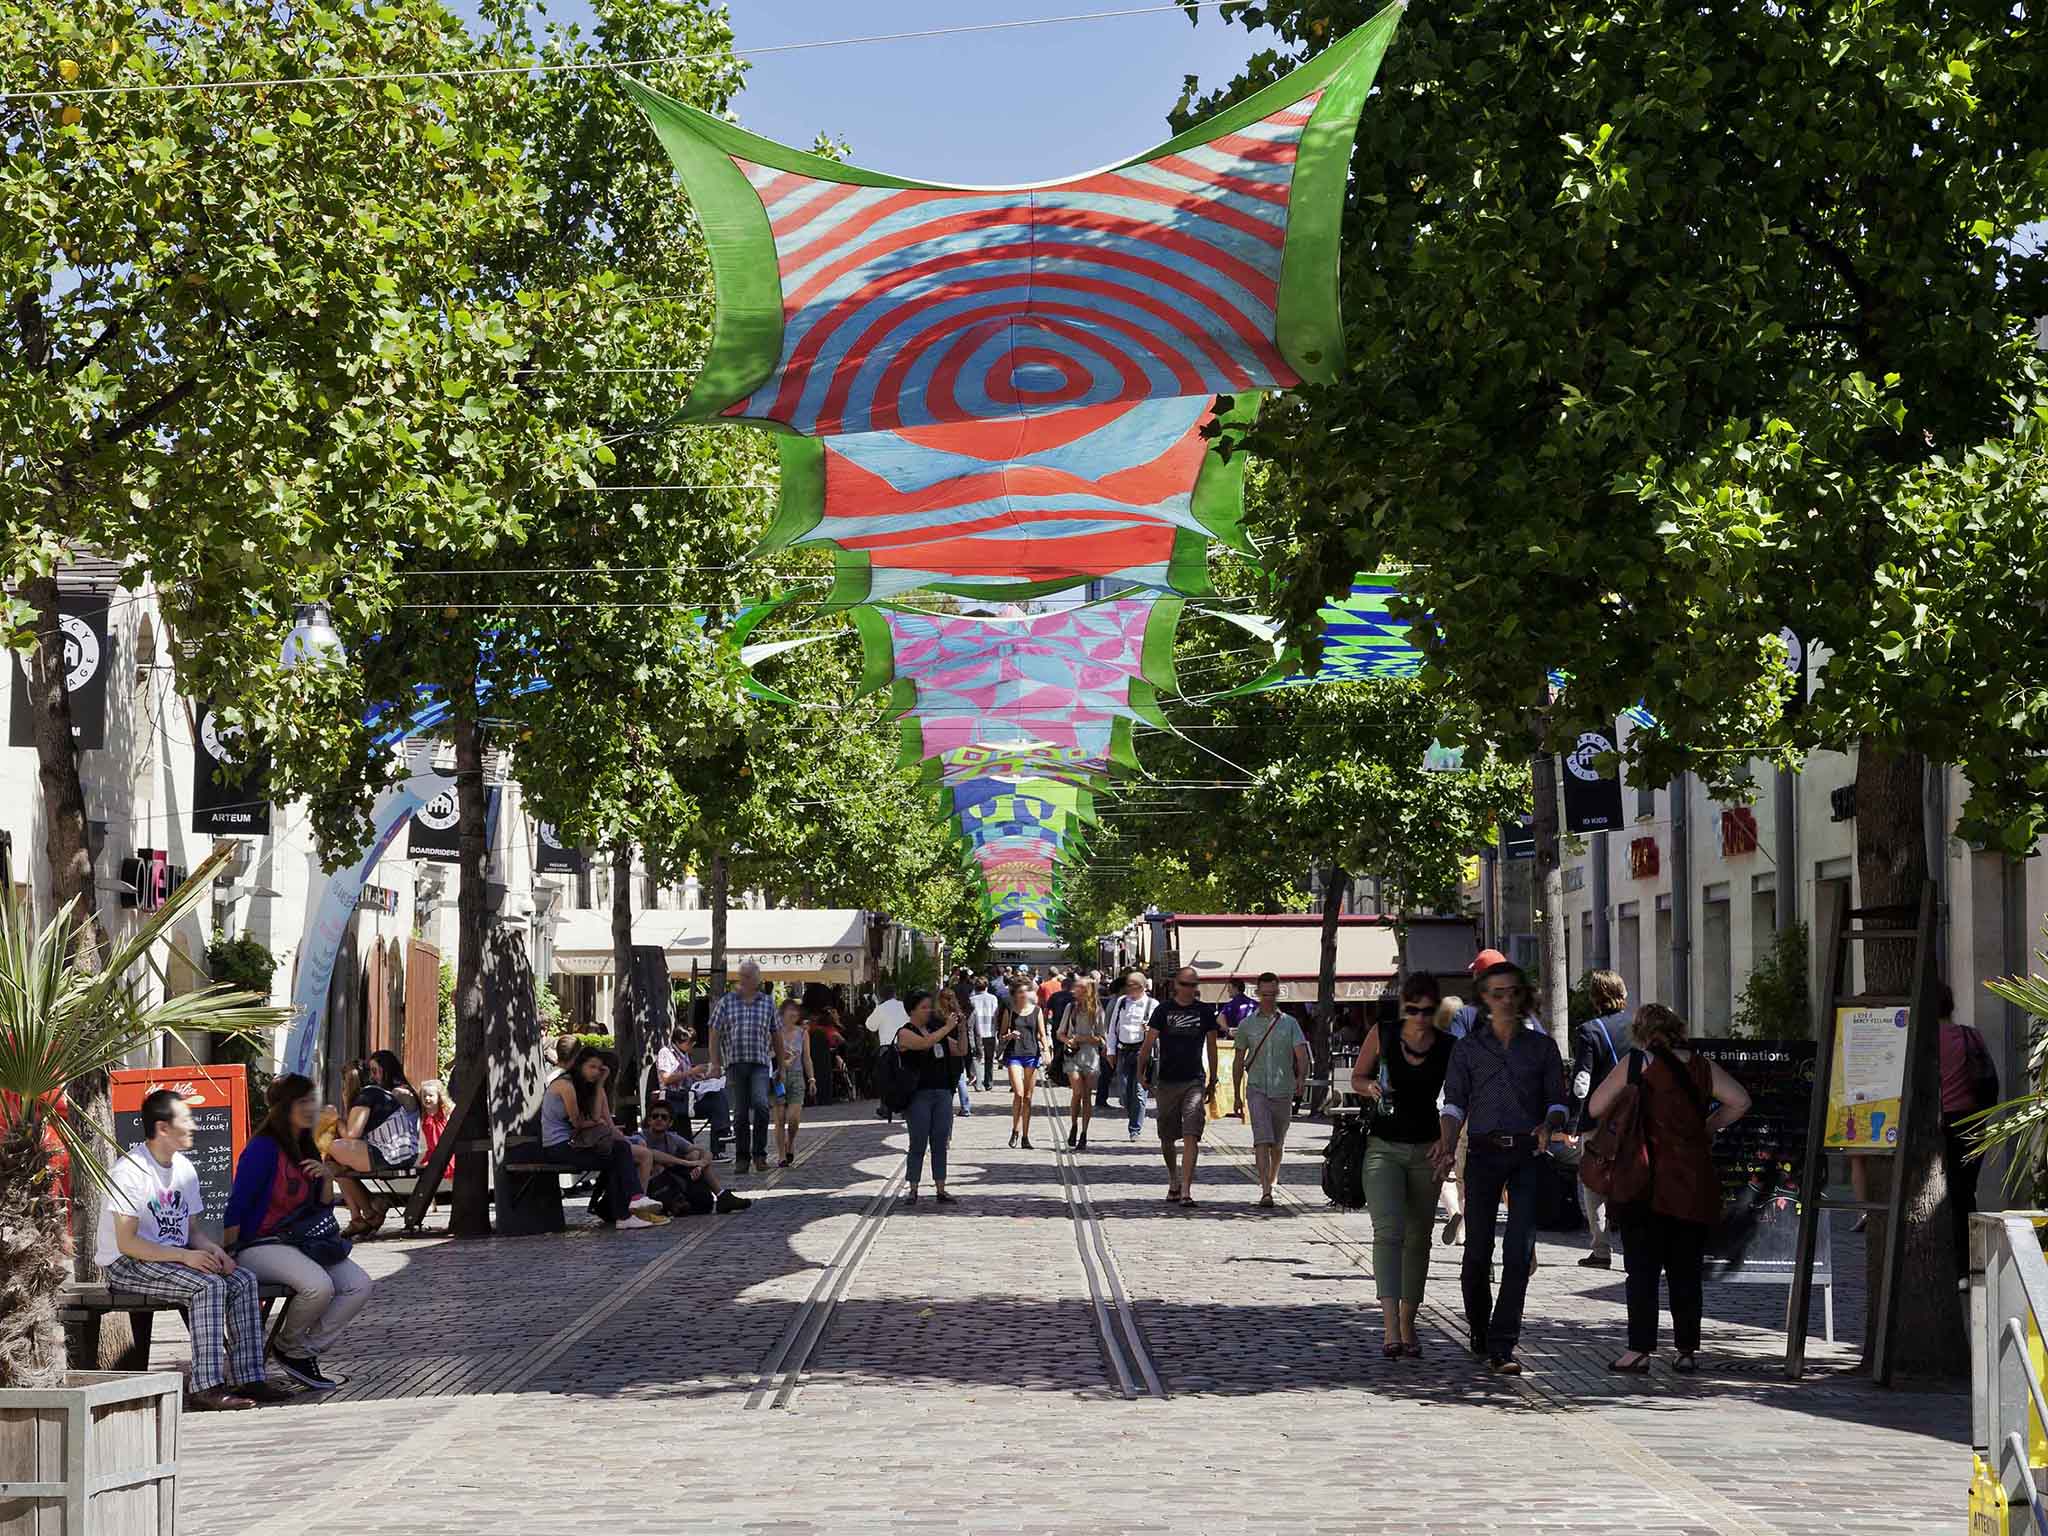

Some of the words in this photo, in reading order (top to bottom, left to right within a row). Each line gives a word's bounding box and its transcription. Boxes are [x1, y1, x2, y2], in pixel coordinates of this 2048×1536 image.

[211, 813, 251, 823] ARTEUM
[1591, 816, 1608, 824] KIDS
[409, 846, 460, 857] BOARDRIDERS
[1345, 983, 1364, 997] La
[1720, 1048, 1791, 1062] animations
